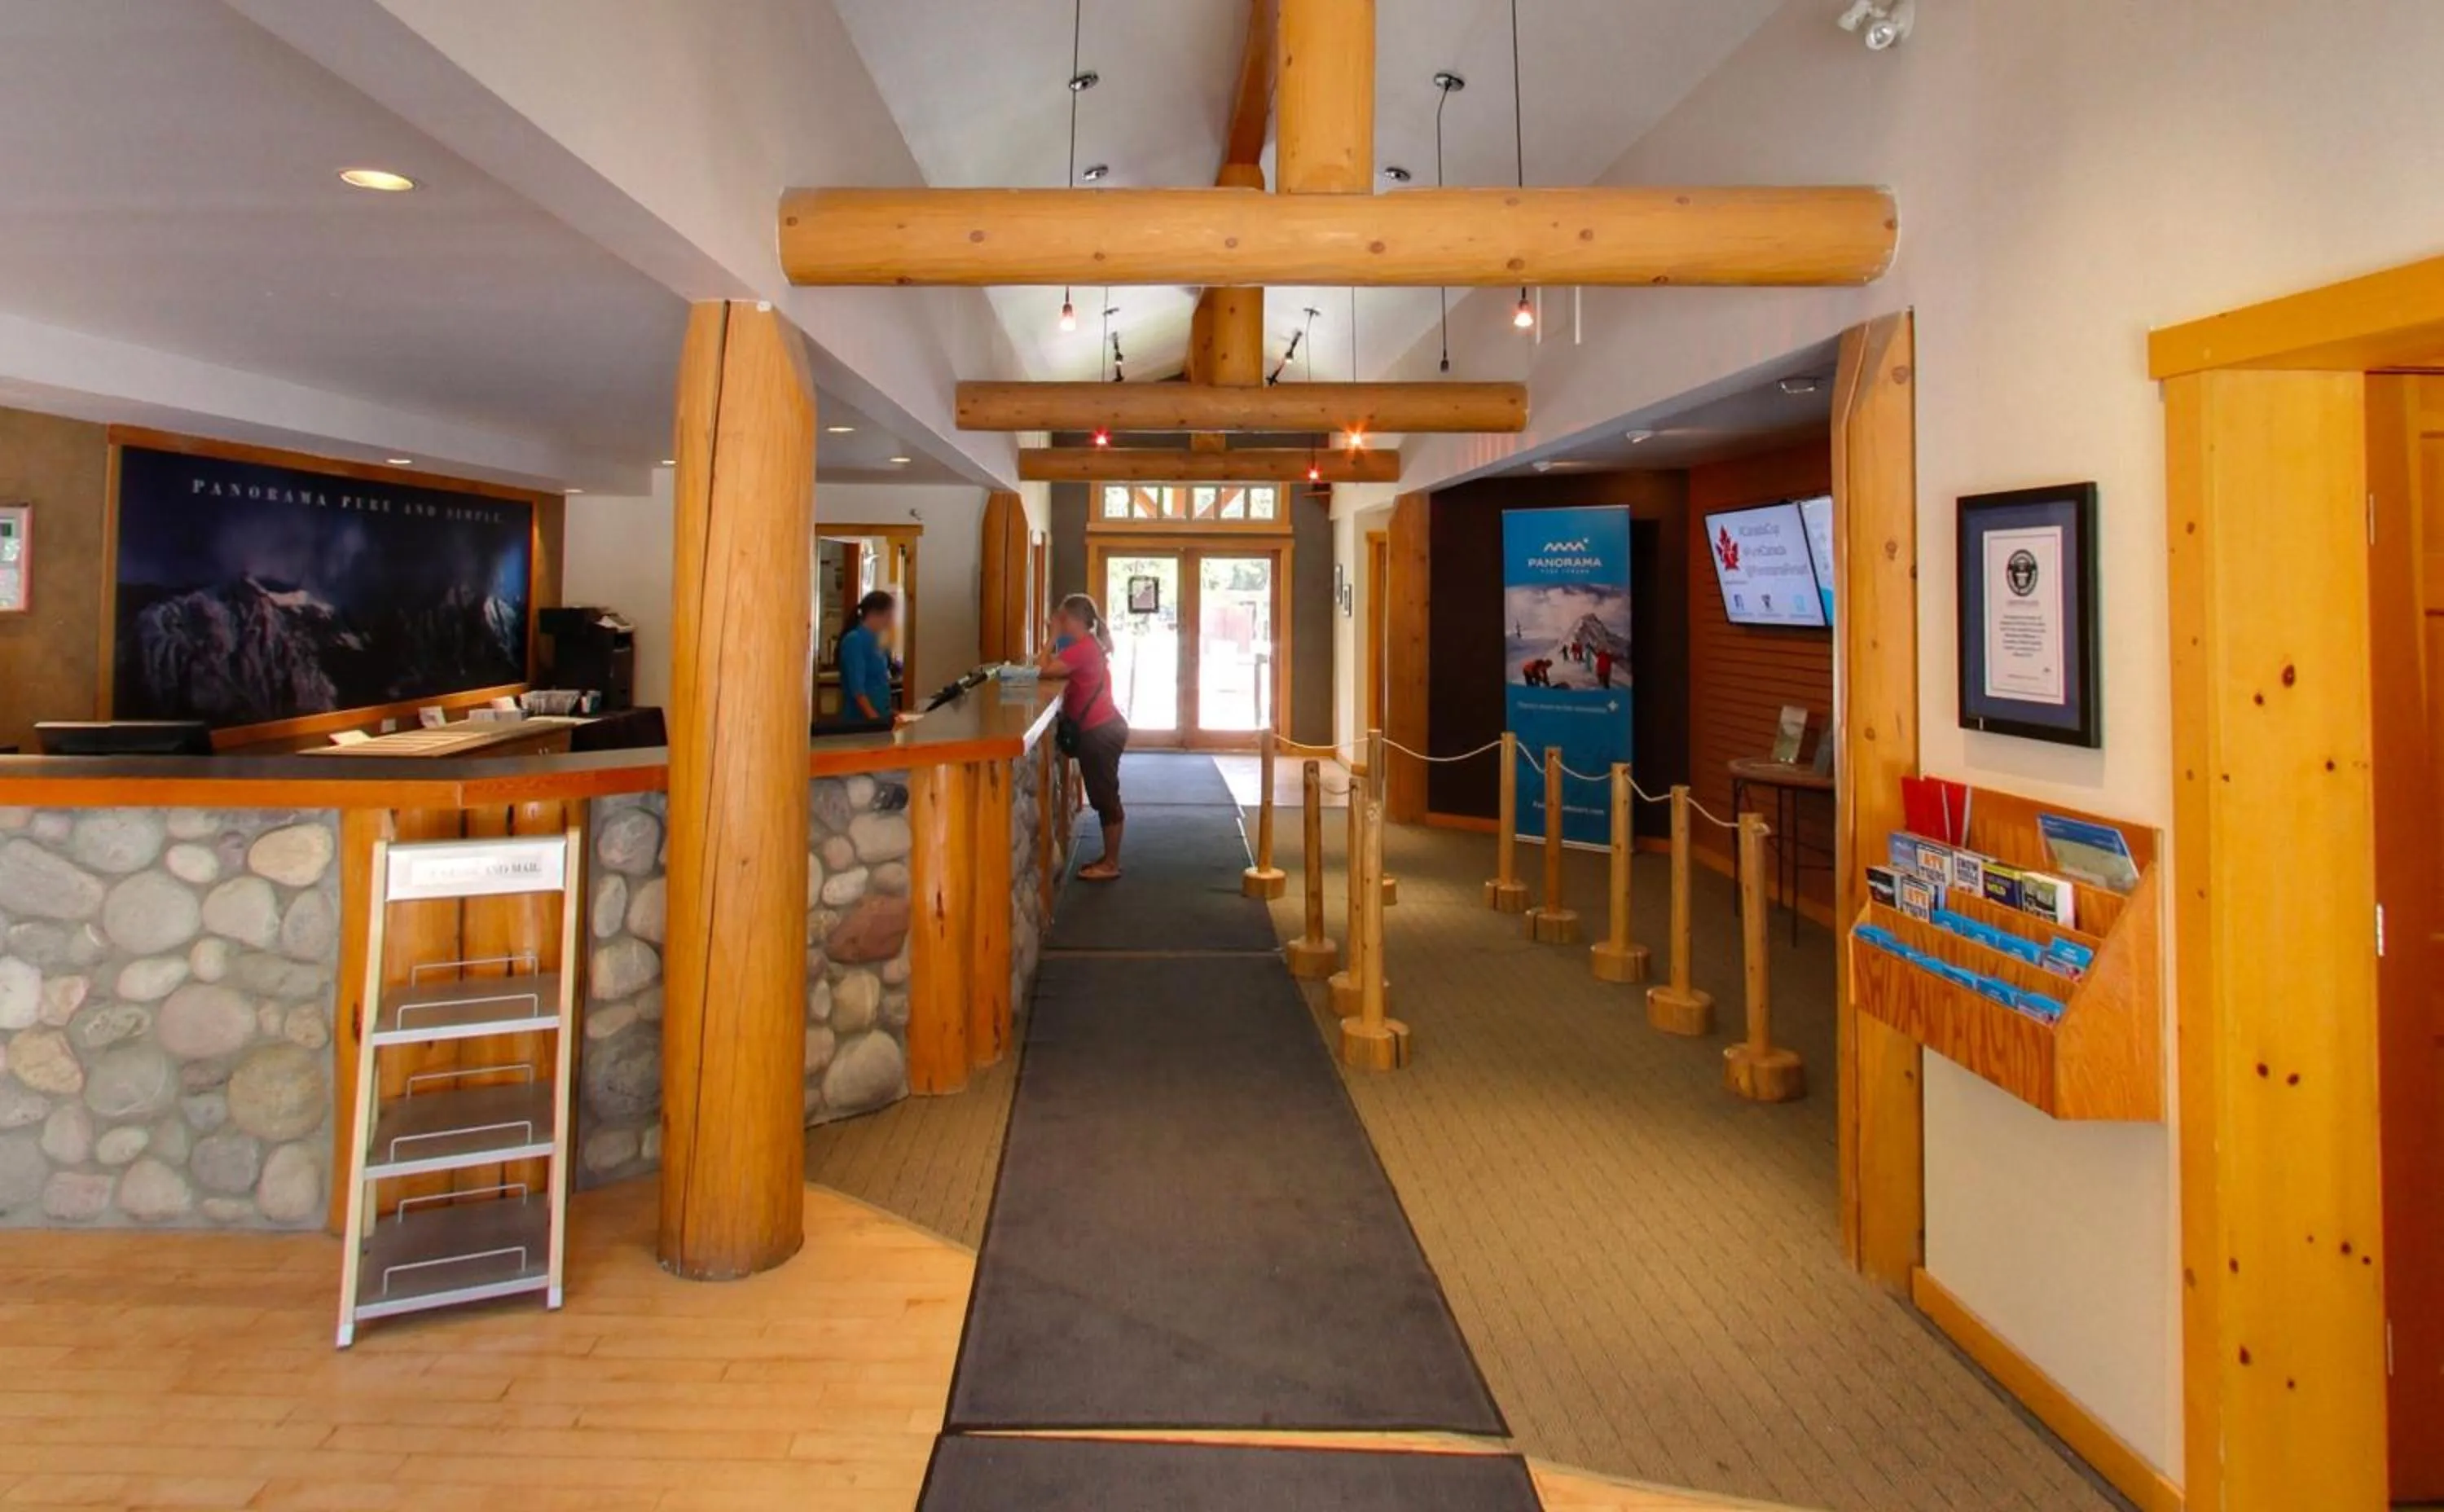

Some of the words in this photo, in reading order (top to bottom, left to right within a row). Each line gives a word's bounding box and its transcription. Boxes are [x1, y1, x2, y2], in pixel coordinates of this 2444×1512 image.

[192, 479, 327, 506] PANORAMA
[342, 495, 391, 512] PURE
[404, 503, 437, 517] AND
[1528, 557, 1603, 568] PANORAMA
